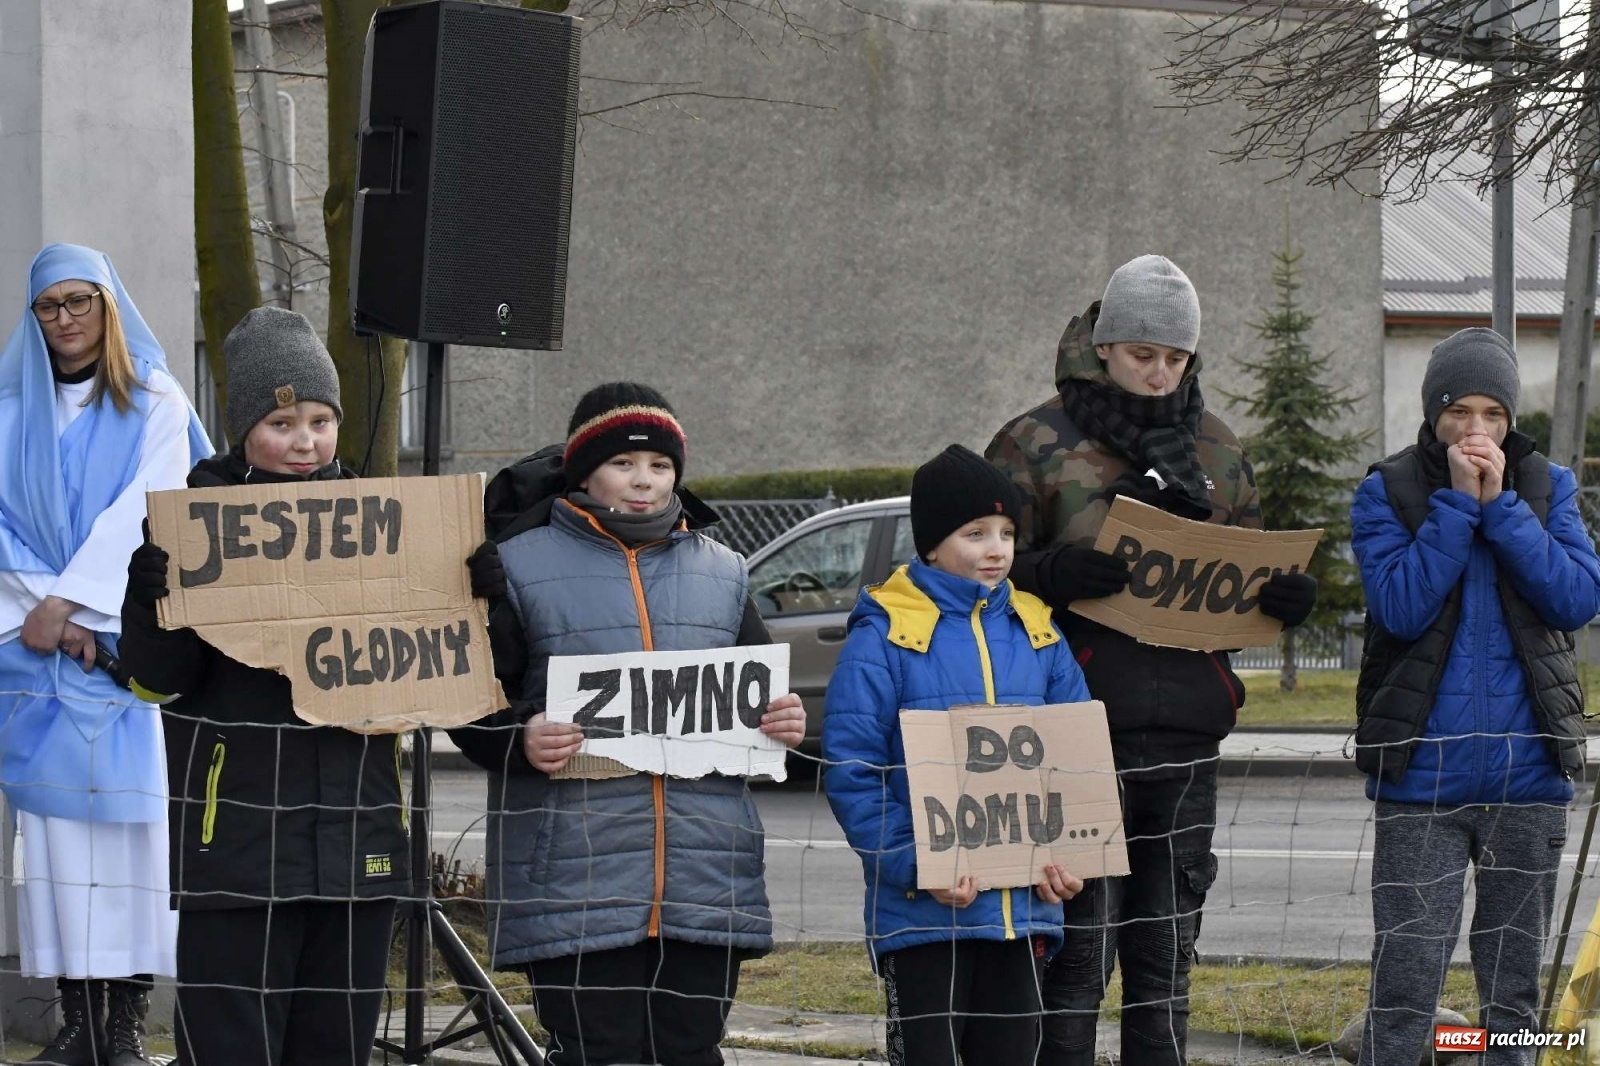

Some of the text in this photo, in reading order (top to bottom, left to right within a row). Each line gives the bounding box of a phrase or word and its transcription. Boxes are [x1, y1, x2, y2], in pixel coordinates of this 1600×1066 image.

[179, 496, 402, 588] JESTEM
[1111, 534, 1299, 615] POMOC
[305, 619, 471, 691] GŁODNY
[572, 660, 771, 739] ZIMNO
[965, 725, 1044, 773] DO
[923, 792, 1099, 852] DOMU...
